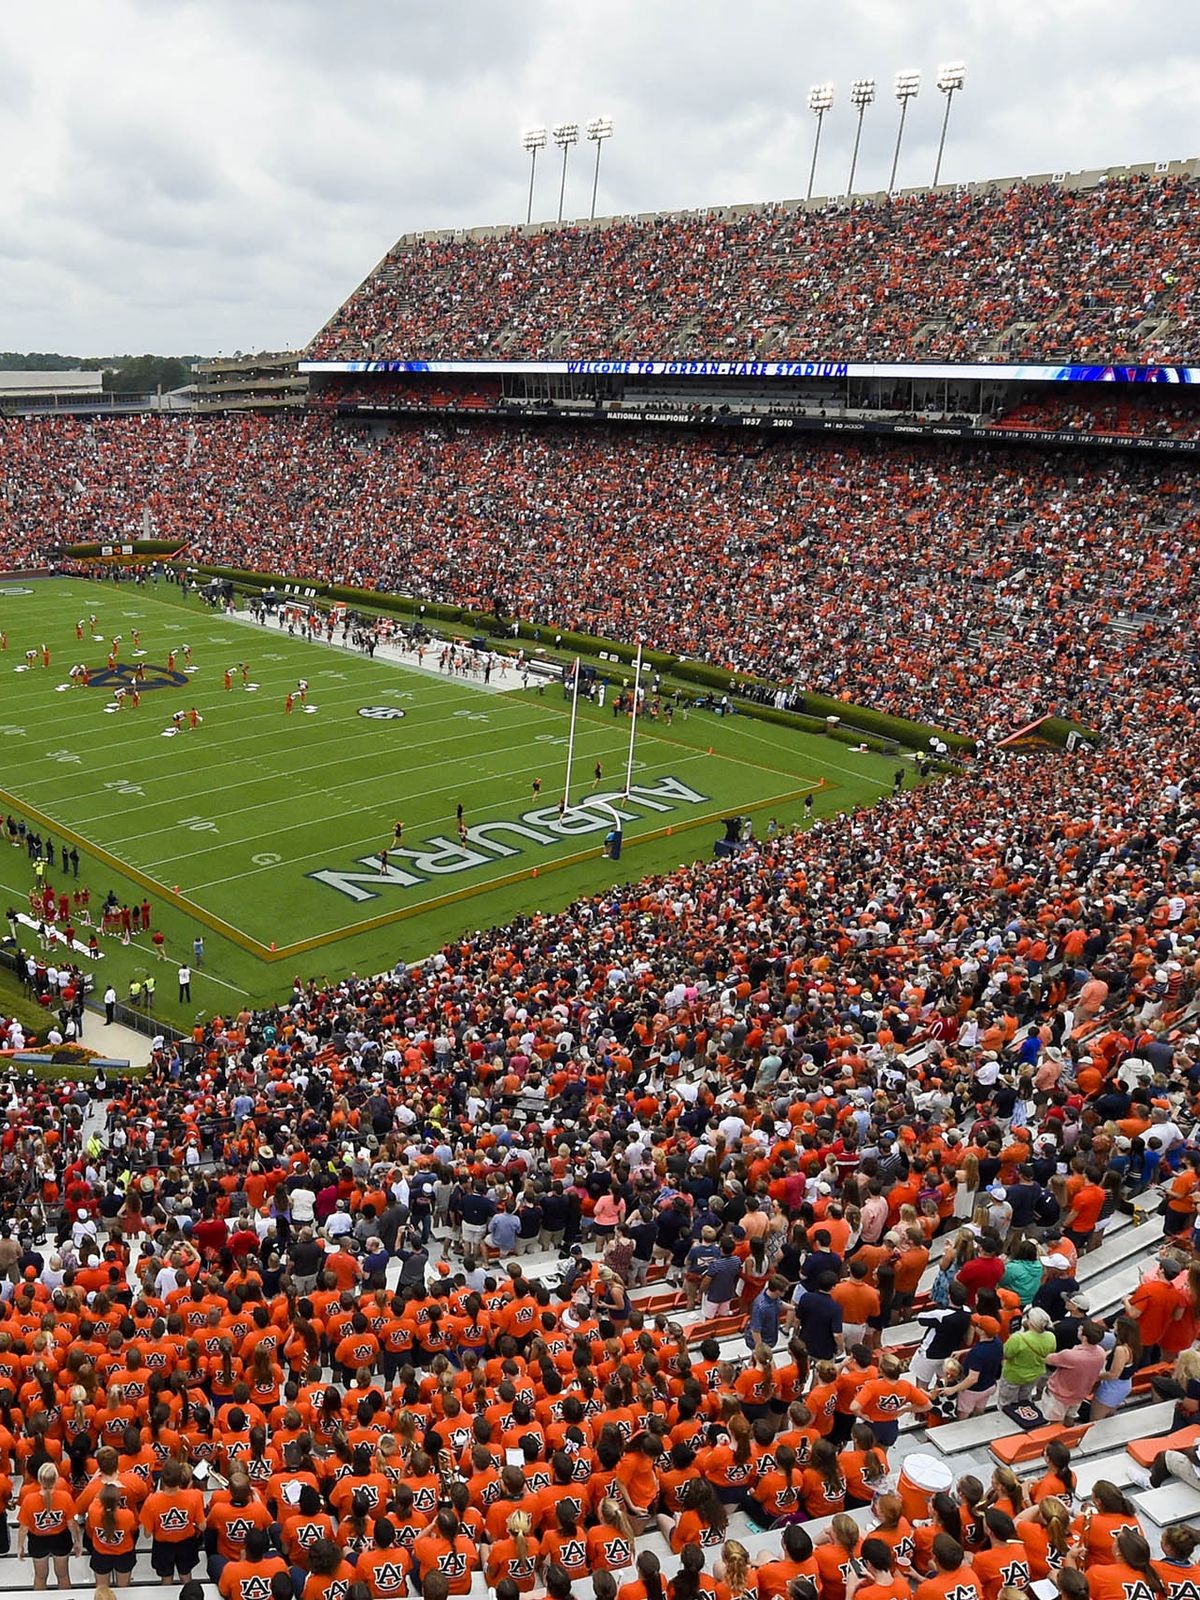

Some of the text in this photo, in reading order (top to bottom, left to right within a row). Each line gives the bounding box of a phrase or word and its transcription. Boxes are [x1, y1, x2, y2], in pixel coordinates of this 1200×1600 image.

[566, 361, 631, 374] WELCOME
[638, 362, 655, 375] TO
[775, 364, 849, 378] STADIUM
[607, 412, 642, 421] NATIONAL
[645, 413, 689, 422] CHAMPIONS
[742, 418, 761, 426] 1957
[772, 419, 793, 427] 2010
[308, 776, 708, 902] AUBURN
